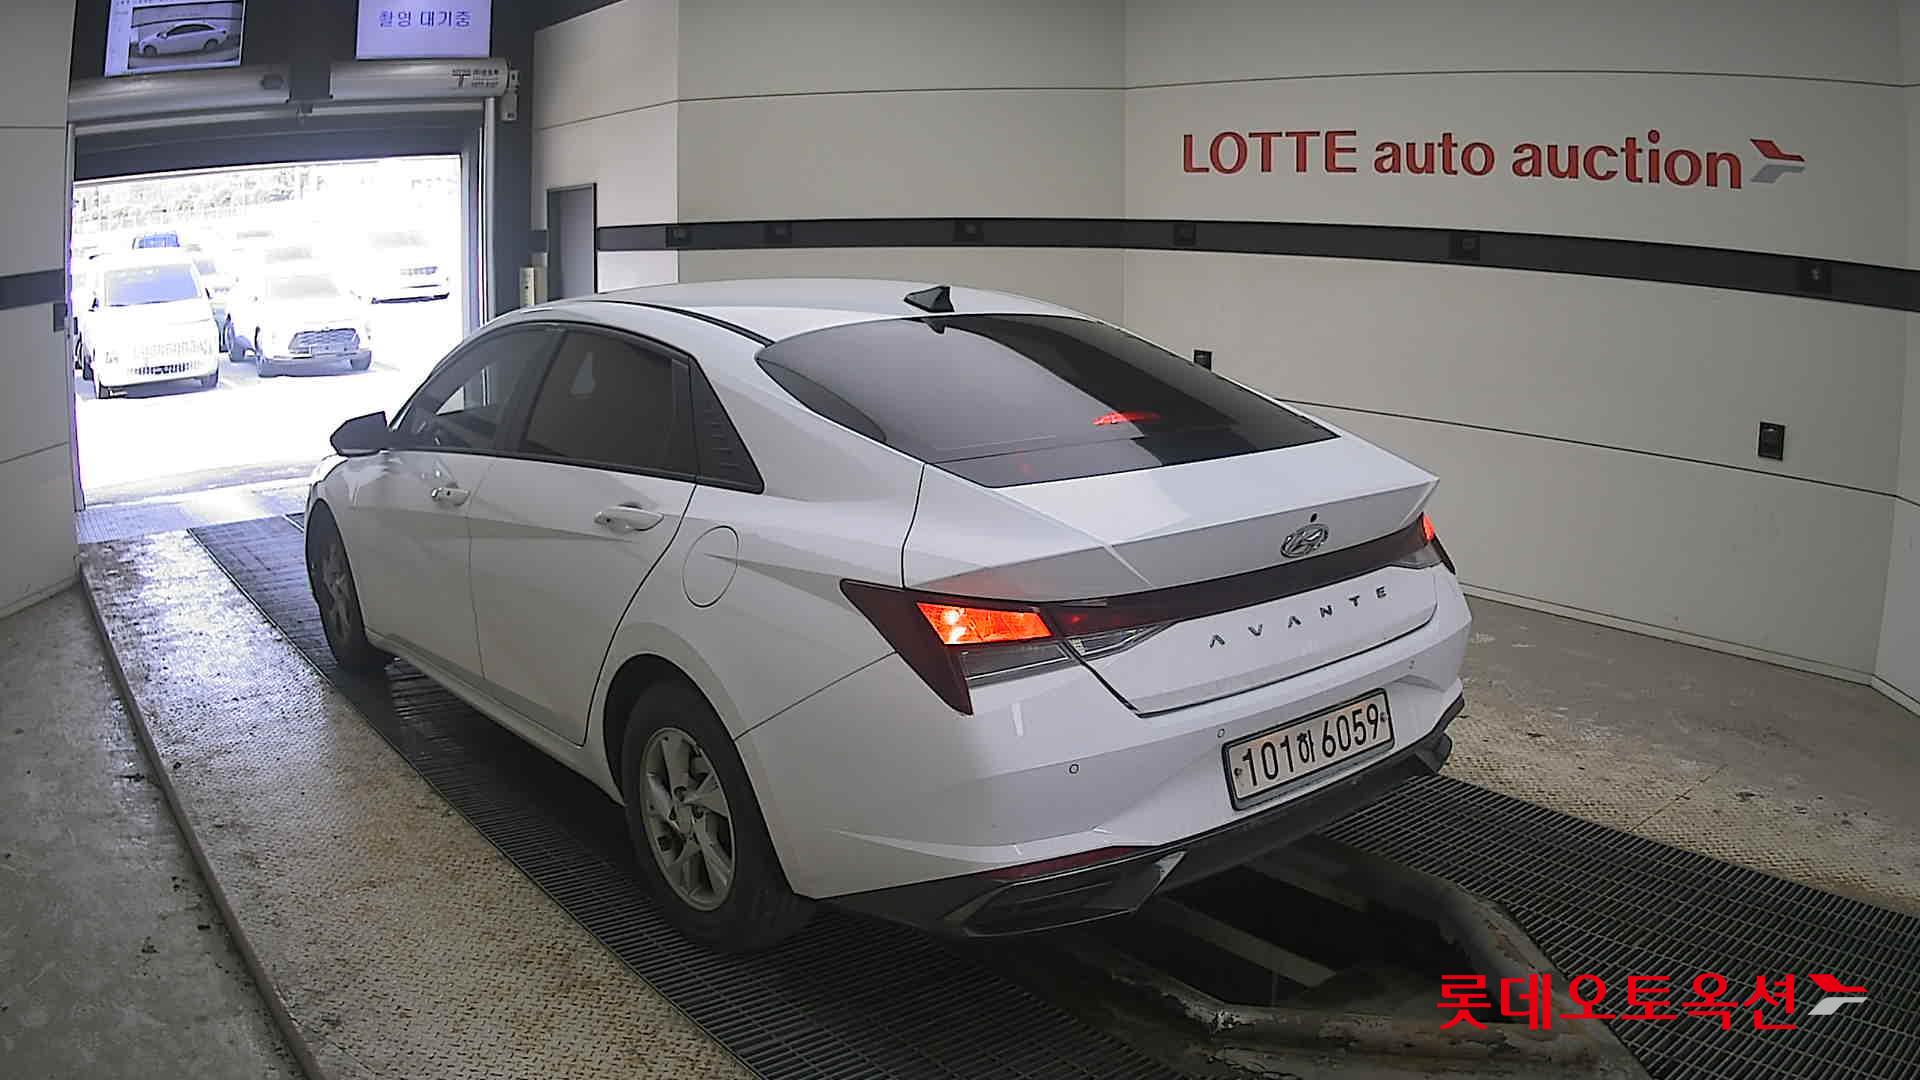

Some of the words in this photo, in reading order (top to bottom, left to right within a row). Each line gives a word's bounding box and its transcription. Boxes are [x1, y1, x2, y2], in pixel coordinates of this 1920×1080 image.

[420, 10, 471, 28] 대기중
[1183, 130, 1358, 174] LOTTE
[1374, 132, 1495, 177] auto
[1512, 130, 1744, 189] auction
[1209, 586, 1387, 649] AVANTE
[1242, 729, 1316, 787] 101하
[1321, 703, 1379, 759] 6059
